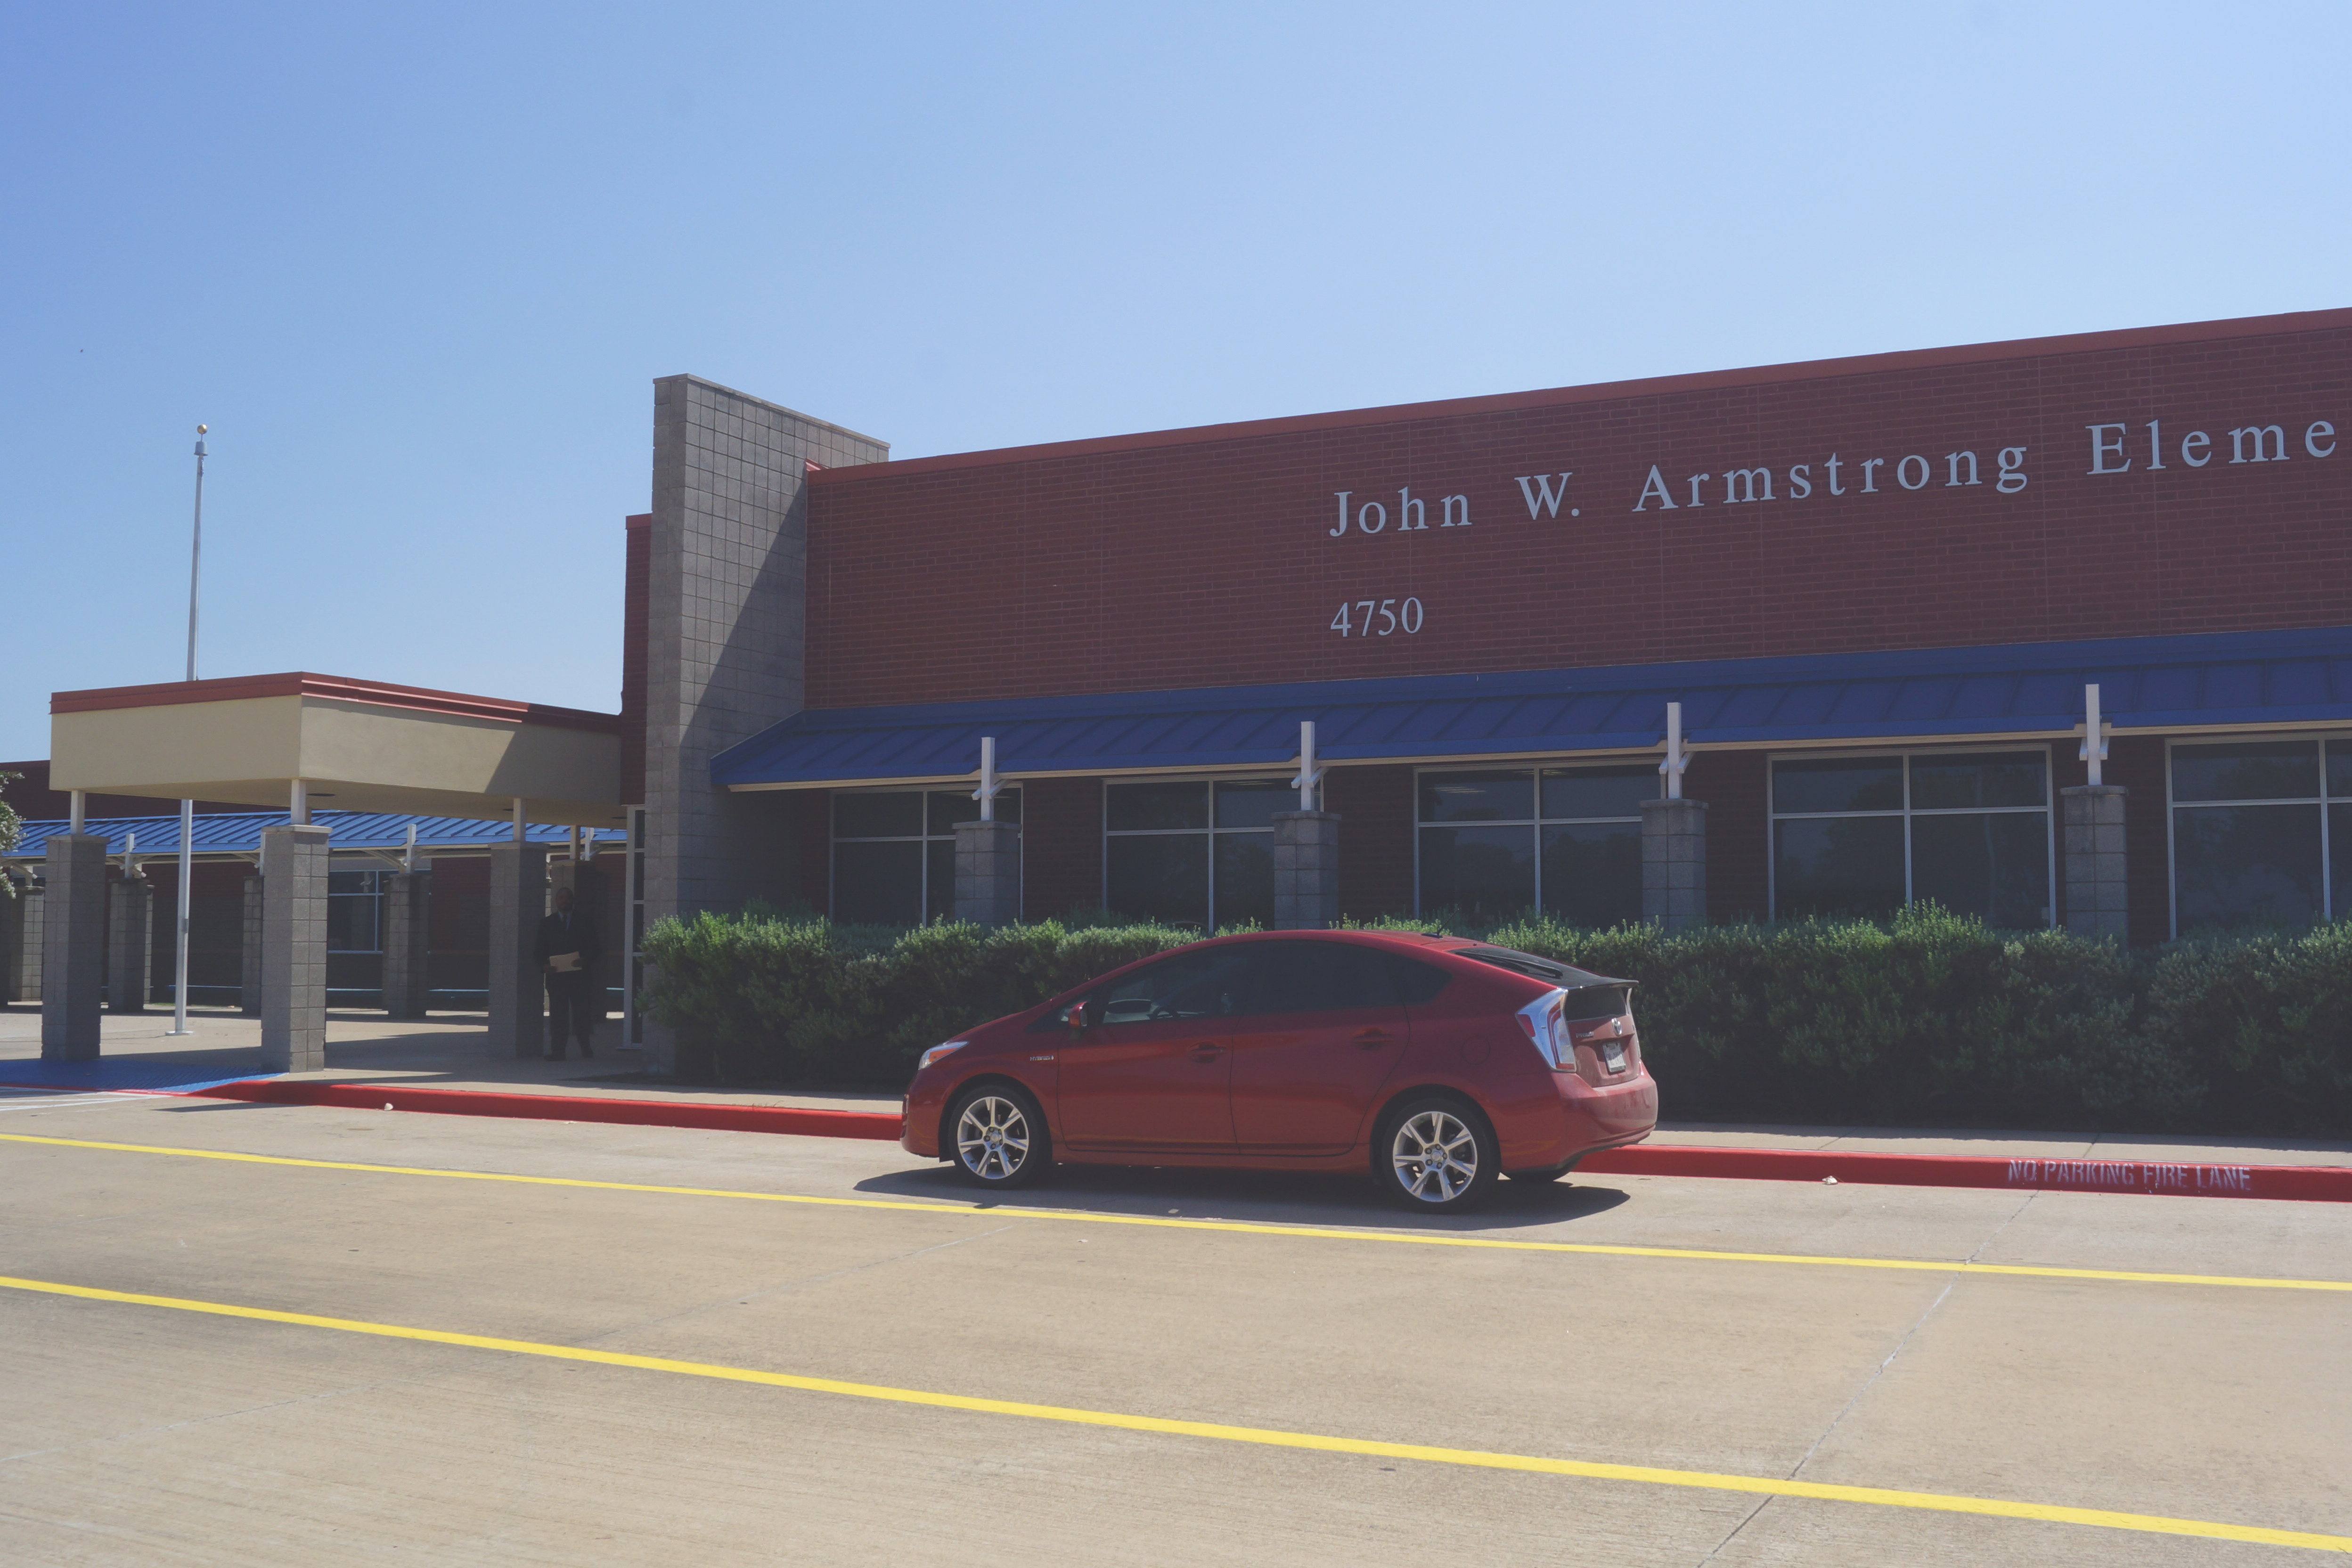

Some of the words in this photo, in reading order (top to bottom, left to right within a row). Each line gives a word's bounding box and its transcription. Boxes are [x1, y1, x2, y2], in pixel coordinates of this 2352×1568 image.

[1329, 486, 1472, 537] John
[1514, 472, 1579, 520] W.
[1632, 447, 2027, 512] Armstrong
[2085, 419, 2336, 474] Eleme
[1331, 597, 1423, 637] 4750
[2008, 1160, 2036, 1182] NO
[2044, 1161, 2134, 1185] PARKING
[2144, 1164, 2188, 1188] FIRE
[2197, 1166, 2251, 1190] LANE
